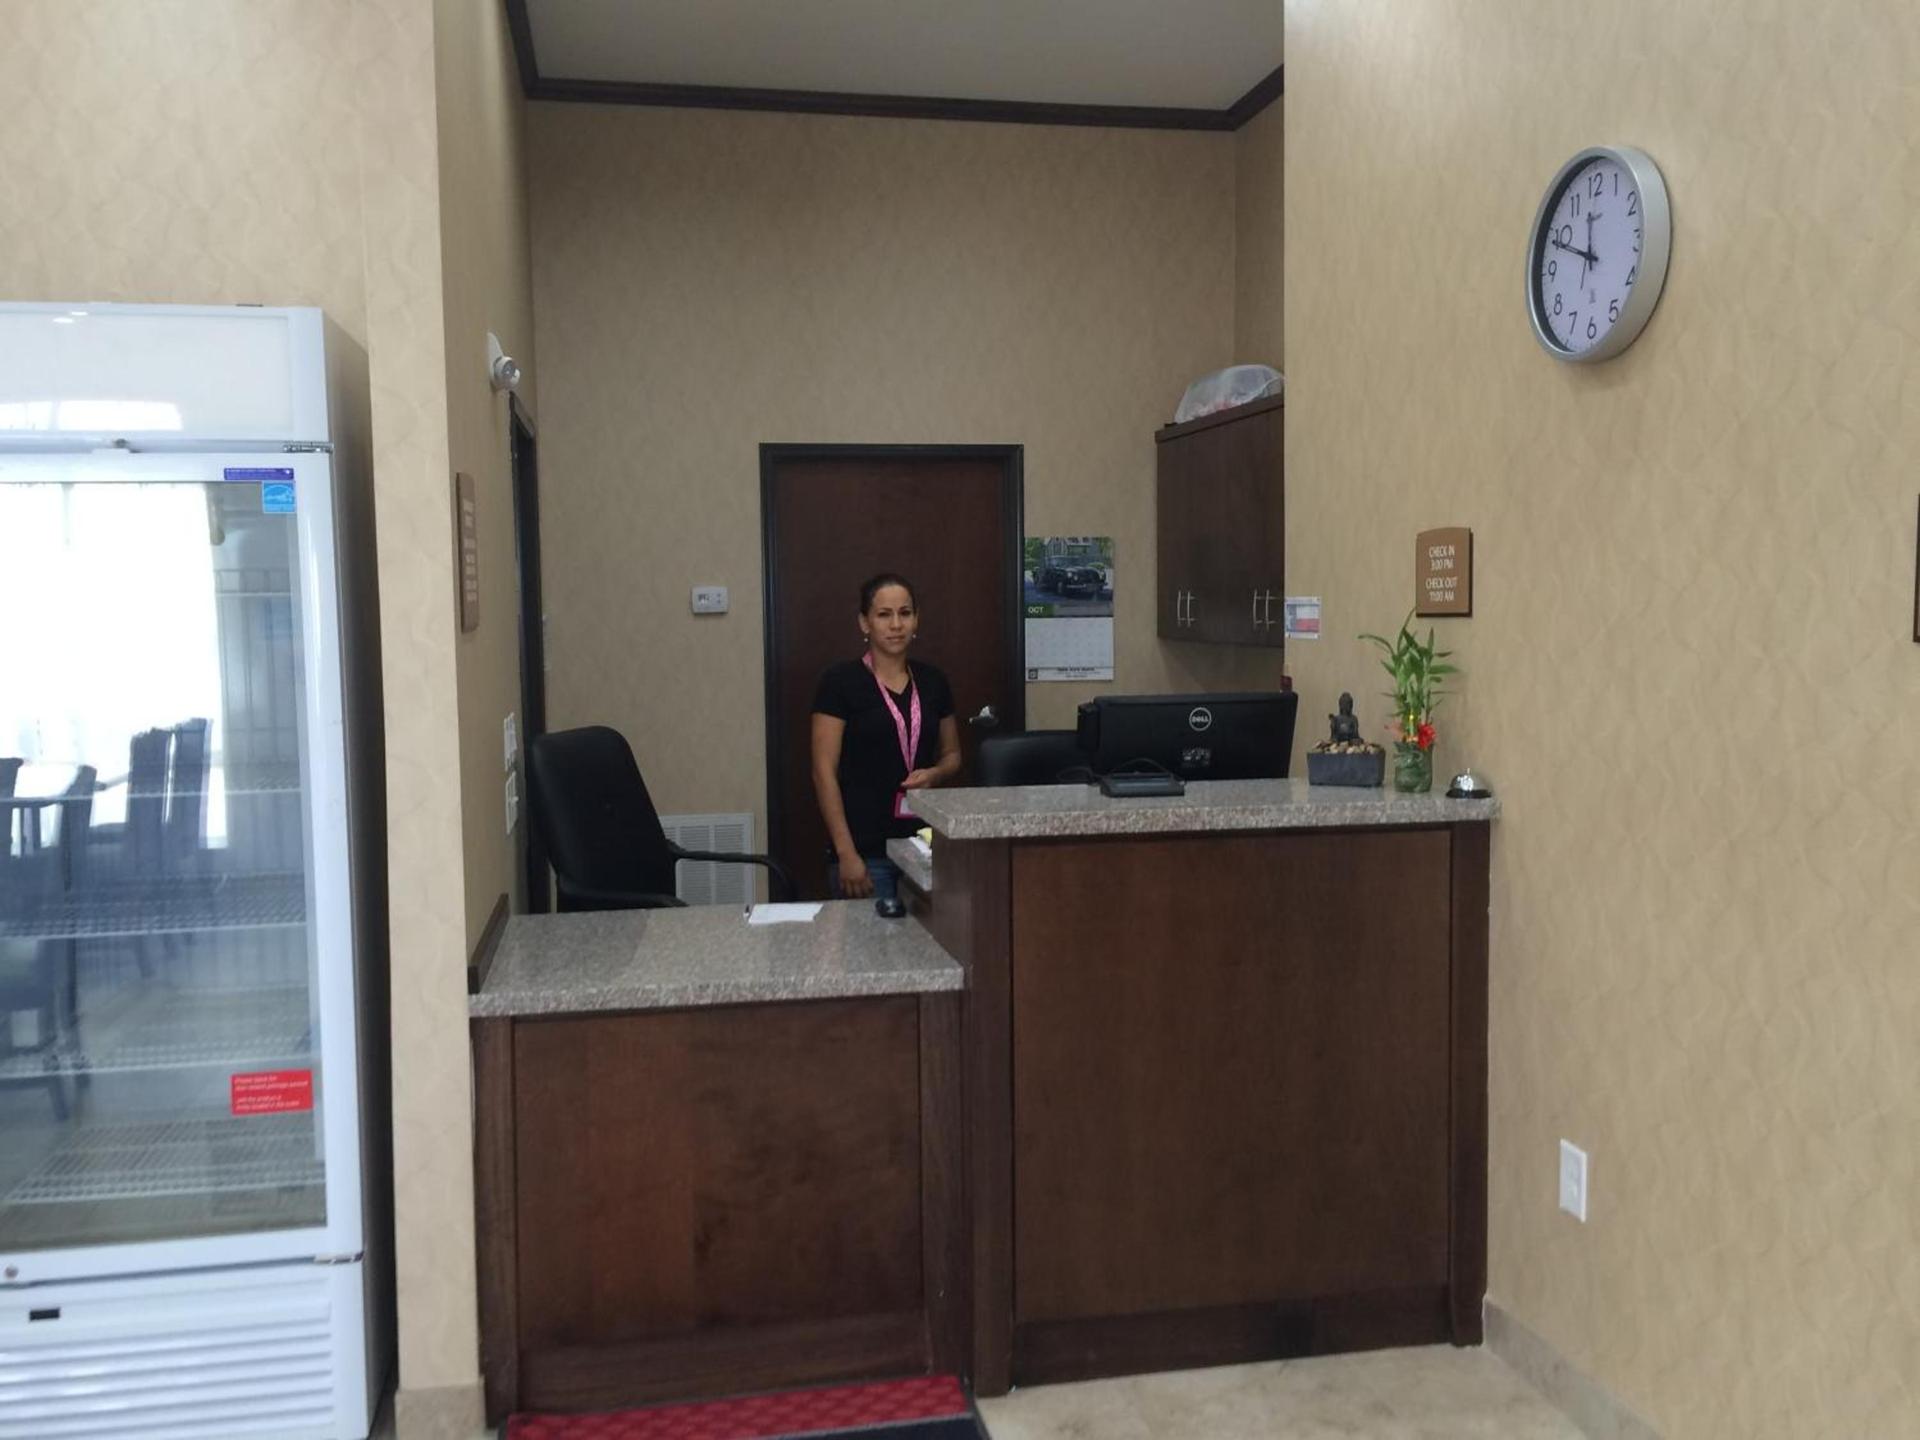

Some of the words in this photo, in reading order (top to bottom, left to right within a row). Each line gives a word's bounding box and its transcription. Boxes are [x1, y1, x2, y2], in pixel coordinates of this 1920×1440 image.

[1588, 172, 1603, 200] 12
[1613, 172, 1619, 196] 1
[1570, 193, 1581, 218] 11
[1627, 190, 1637, 216] 2
[1554, 224, 1573, 250] 10
[1547, 260, 1558, 283] 9
[1553, 292, 1563, 316] 8
[1608, 298, 1619, 323] 5
[1568, 311, 1578, 336] 7
[1586, 315, 1597, 339] 6
[1429, 545, 1447, 558] CHECK
[1448, 544, 1455, 557] IN
[1443, 558, 1454, 569] PM
[1425, 577, 1444, 590] CHECK
[1444, 576, 1458, 589] OUT
[1444, 590, 1455, 601] AM
[1027, 606, 1044, 614] OCT
[1191, 715, 1209, 723] DELL
